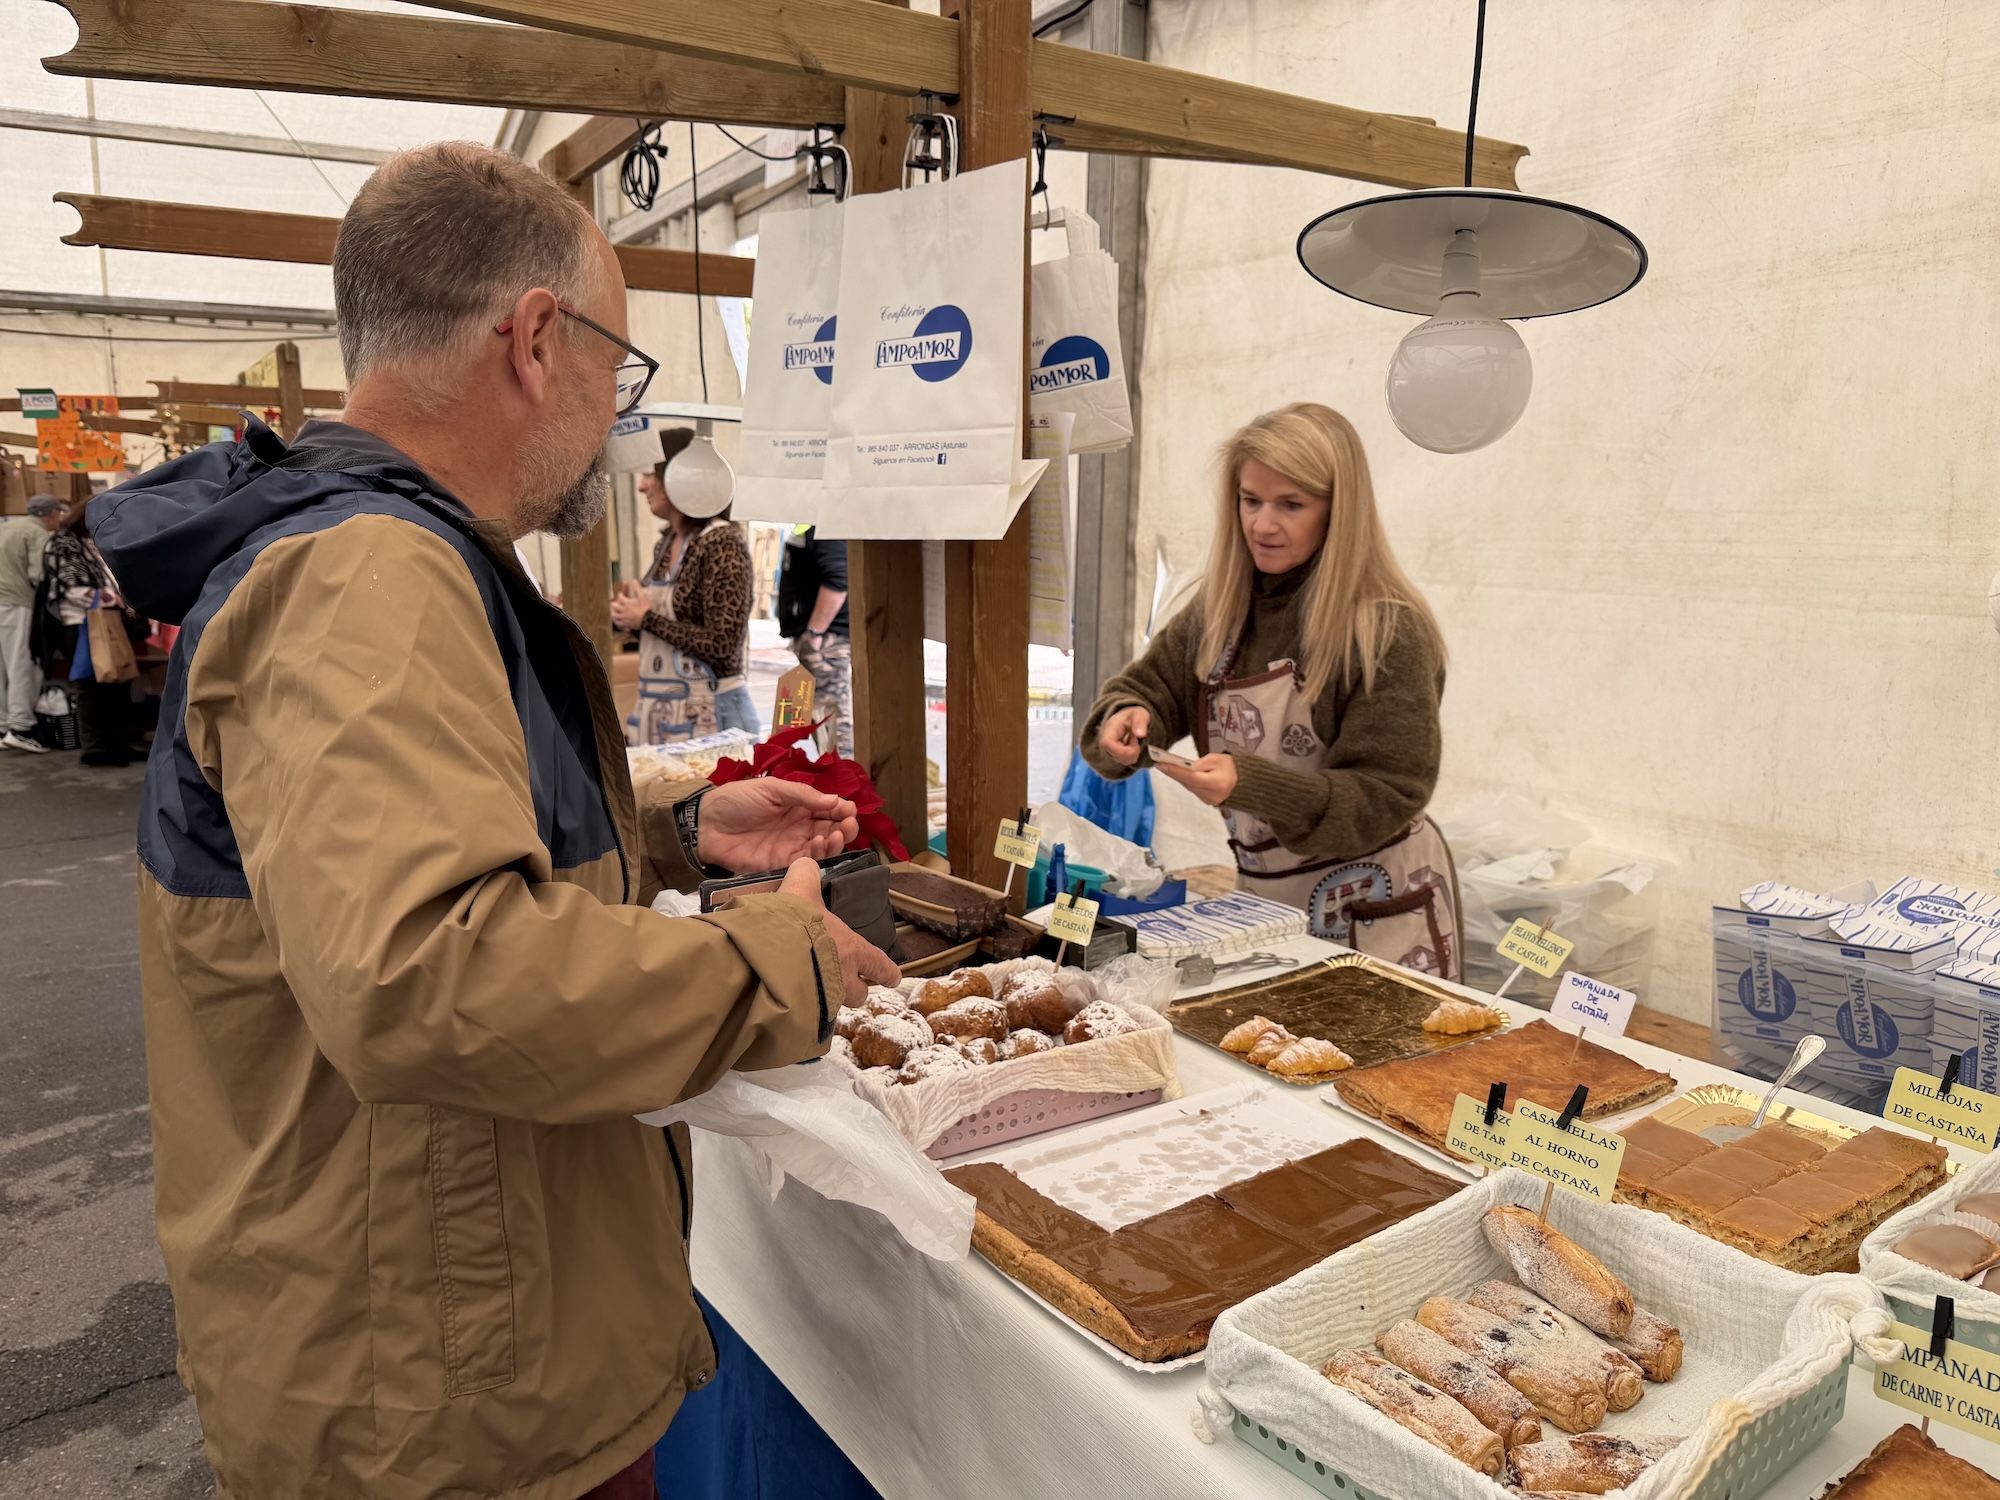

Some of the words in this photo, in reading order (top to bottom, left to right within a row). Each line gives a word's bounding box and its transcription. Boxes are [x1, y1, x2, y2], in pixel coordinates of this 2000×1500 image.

[876, 338, 956, 368] CAMPOAMOR
[1030, 364, 1096, 391] POAMOR
[1053, 917, 1062, 927] DE
[1505, 941, 1517, 952] DE
[1516, 946, 1549, 968] CASTAÑA
[1571, 976, 1621, 1002] EMPANADA
[1587, 993, 1599, 1005] DE
[1907, 1081, 1983, 1114] MILHOJAS
[1463, 1121, 1479, 1135] DE
[1520, 1106, 1618, 1151] CASAIELLAS
[1892, 1103, 1913, 1118] DE
[1916, 1111, 1987, 1144] CASTAÑA
[1451, 1137, 1467, 1151] DE
[1469, 1146, 1515, 1168] CASTA
[1525, 1134, 1544, 1148] AL
[1546, 1141, 1599, 1169] HORNO
[1511, 1151, 1529, 1167] DE
[1532, 1161, 1600, 1197] CASTAÑA
[1898, 1342, 2000, 1393] MPANAD
[1881, 1371, 1898, 1392] DE
[1900, 1379, 1943, 1408] CARNE
[1946, 1394, 1955, 1413] Y
